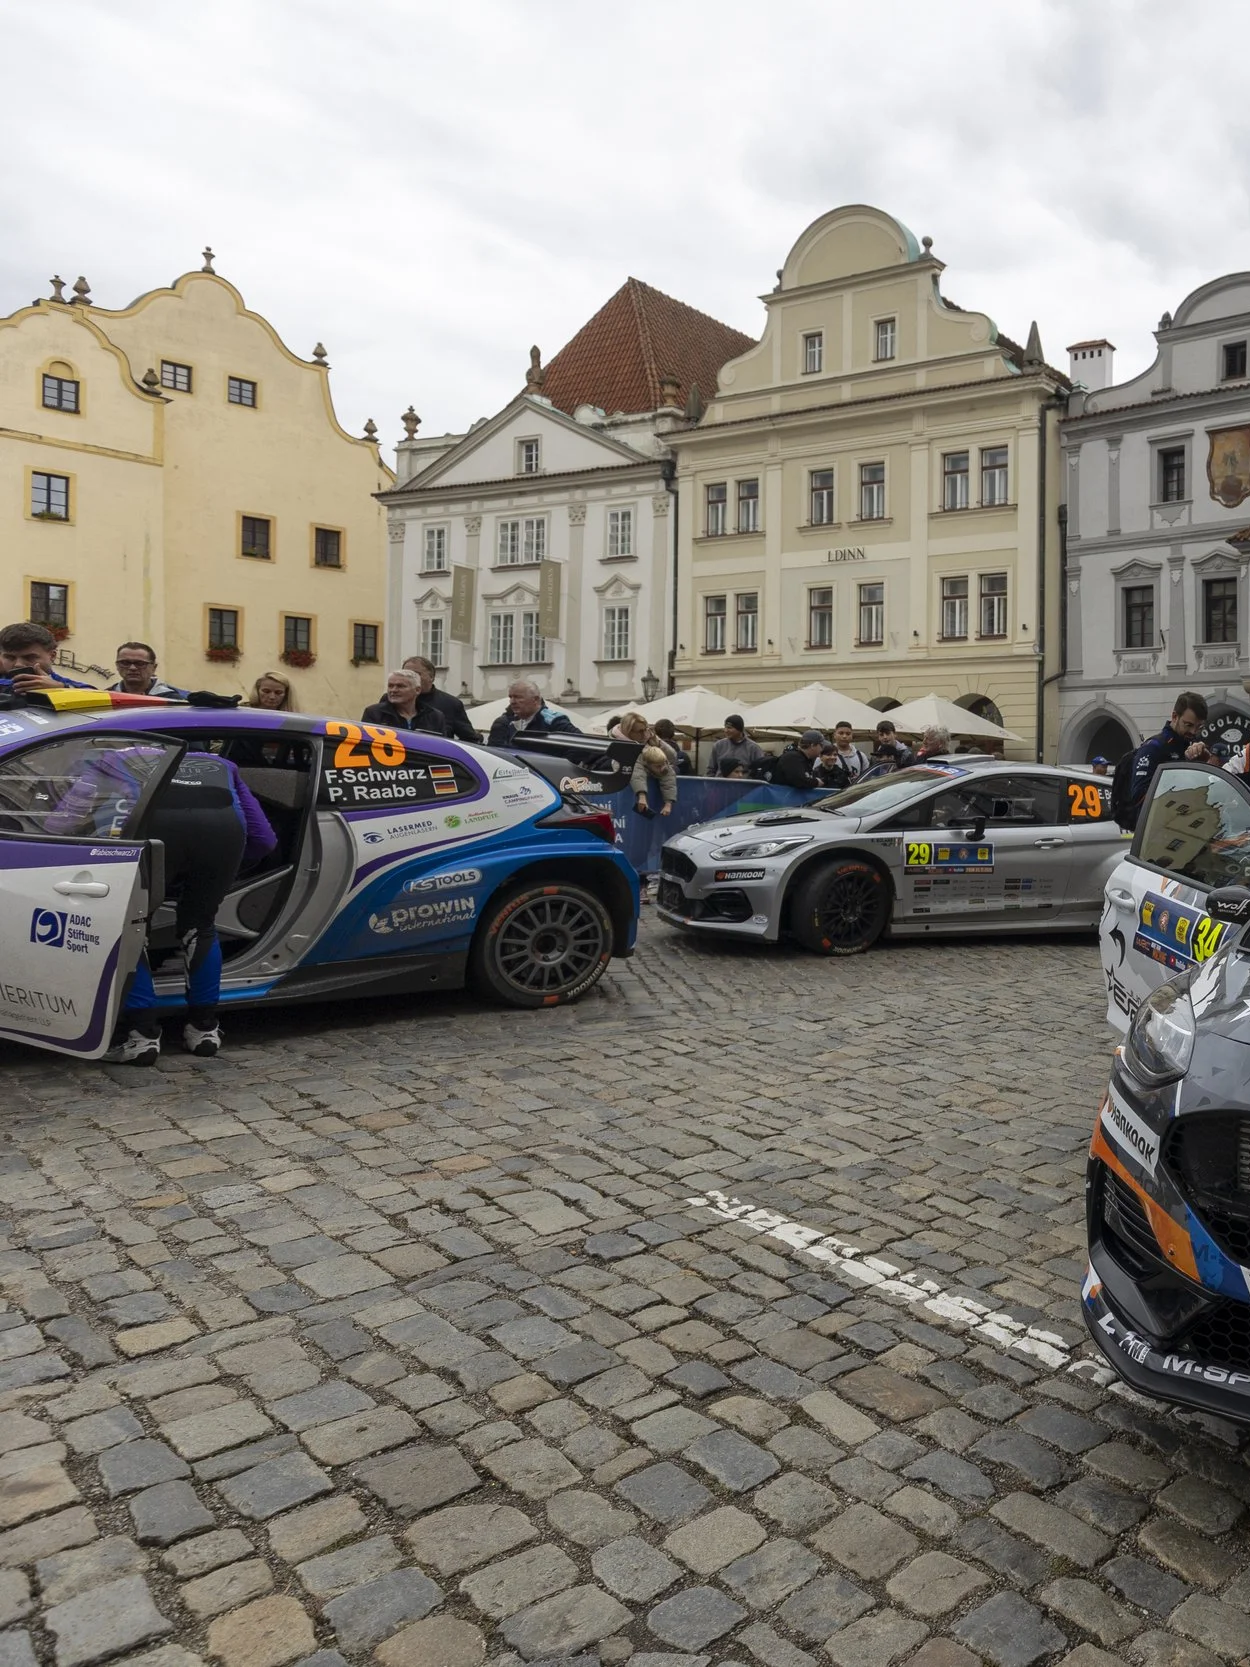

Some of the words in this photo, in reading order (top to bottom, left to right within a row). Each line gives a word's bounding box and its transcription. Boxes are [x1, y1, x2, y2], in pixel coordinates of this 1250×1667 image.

[326, 721, 406, 768] 28
[324, 768, 427, 784] F.Schwarz
[328, 786, 347, 802] P.
[353, 784, 417, 800] Raabe
[1068, 784, 1102, 818] 29
[387, 820, 433, 835] LASERMED
[908, 843, 930, 865] 29
[69, 913, 92, 928] ADAC
[67, 928, 100, 945] Stiftung
[1194, 917, 1223, 962] 34
[66, 940, 89, 954] Sport
